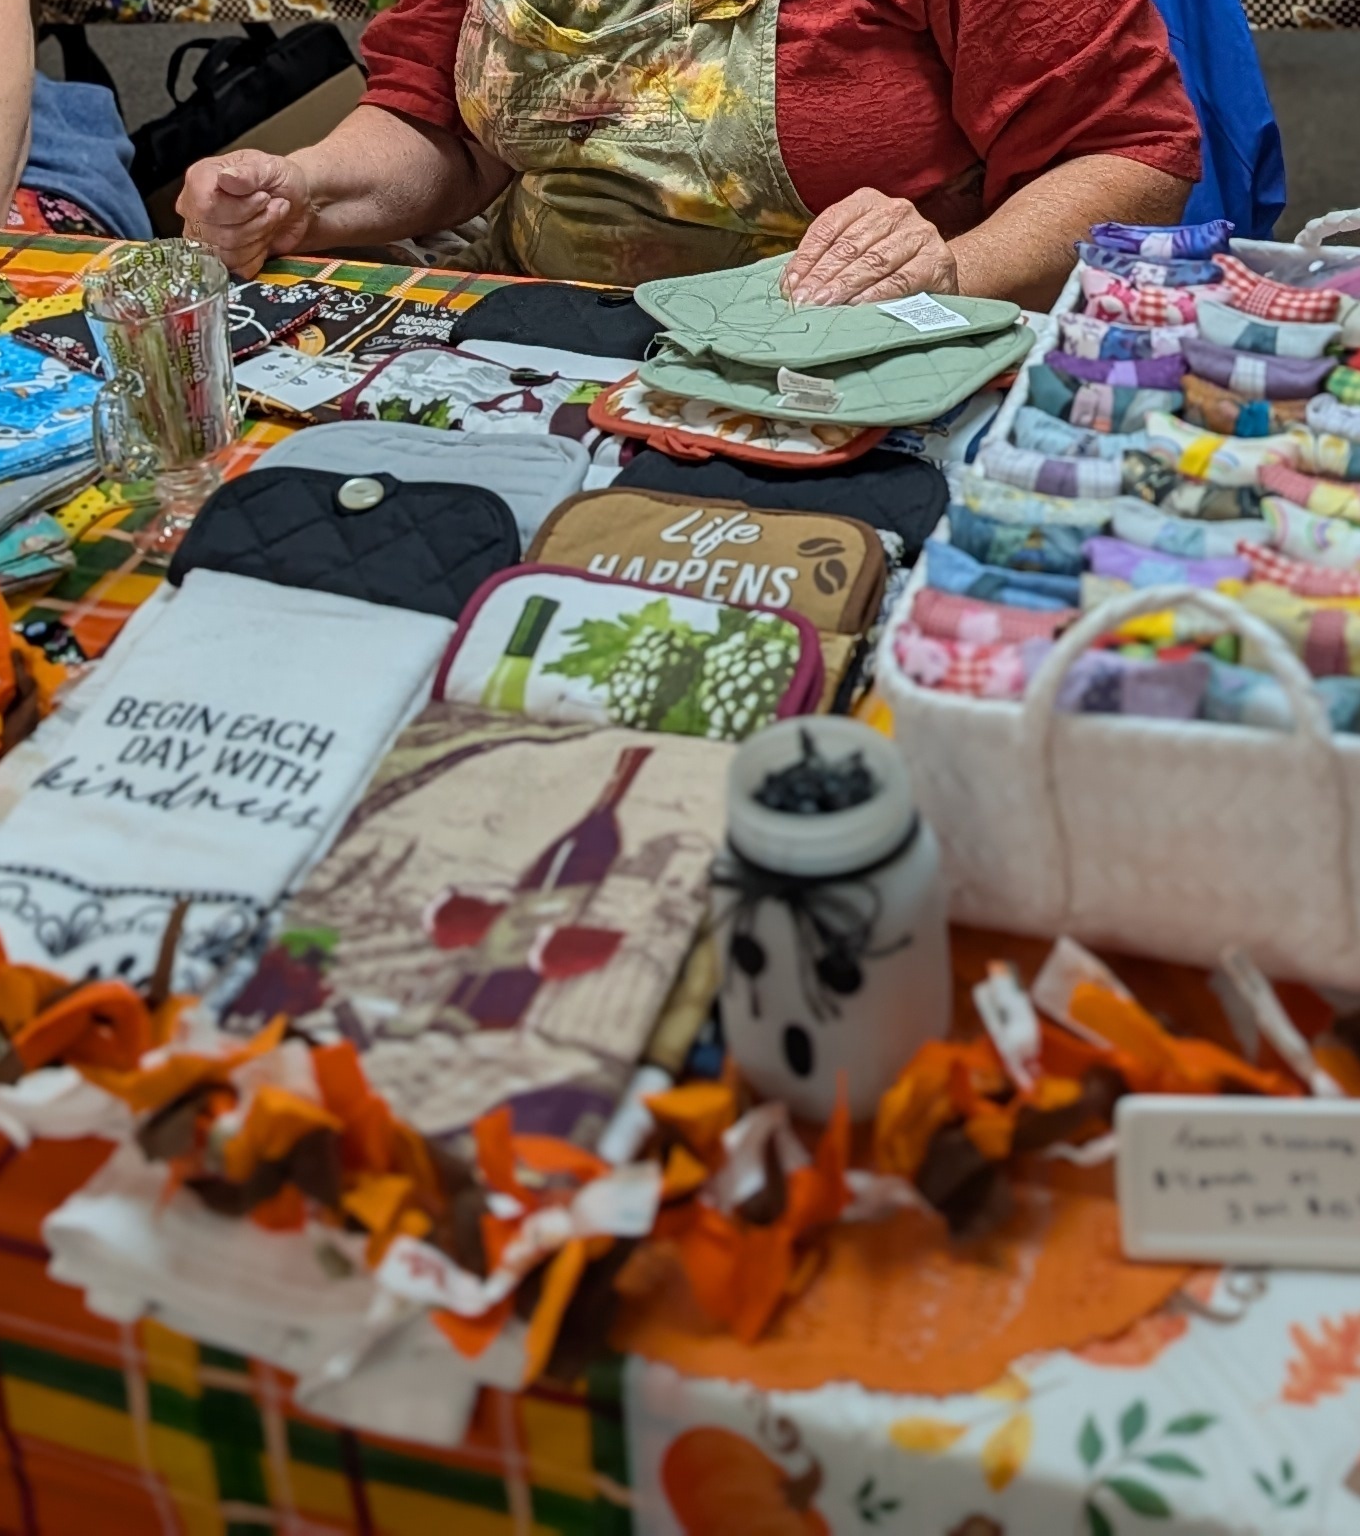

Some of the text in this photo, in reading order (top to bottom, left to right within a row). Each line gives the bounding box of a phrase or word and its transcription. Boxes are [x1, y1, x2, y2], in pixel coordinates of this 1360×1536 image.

[391, 325, 451, 343] COFFE
[395, 313, 455, 331] MORNI
[187, 331, 208, 383] PUNCH
[659, 509, 762, 558] Life
[586, 553, 799, 609] HAPPENS
[105, 695, 336, 762] BEGIN EACH
[116, 734, 323, 796] DAY WITH
[30, 756, 326, 830] kindness
